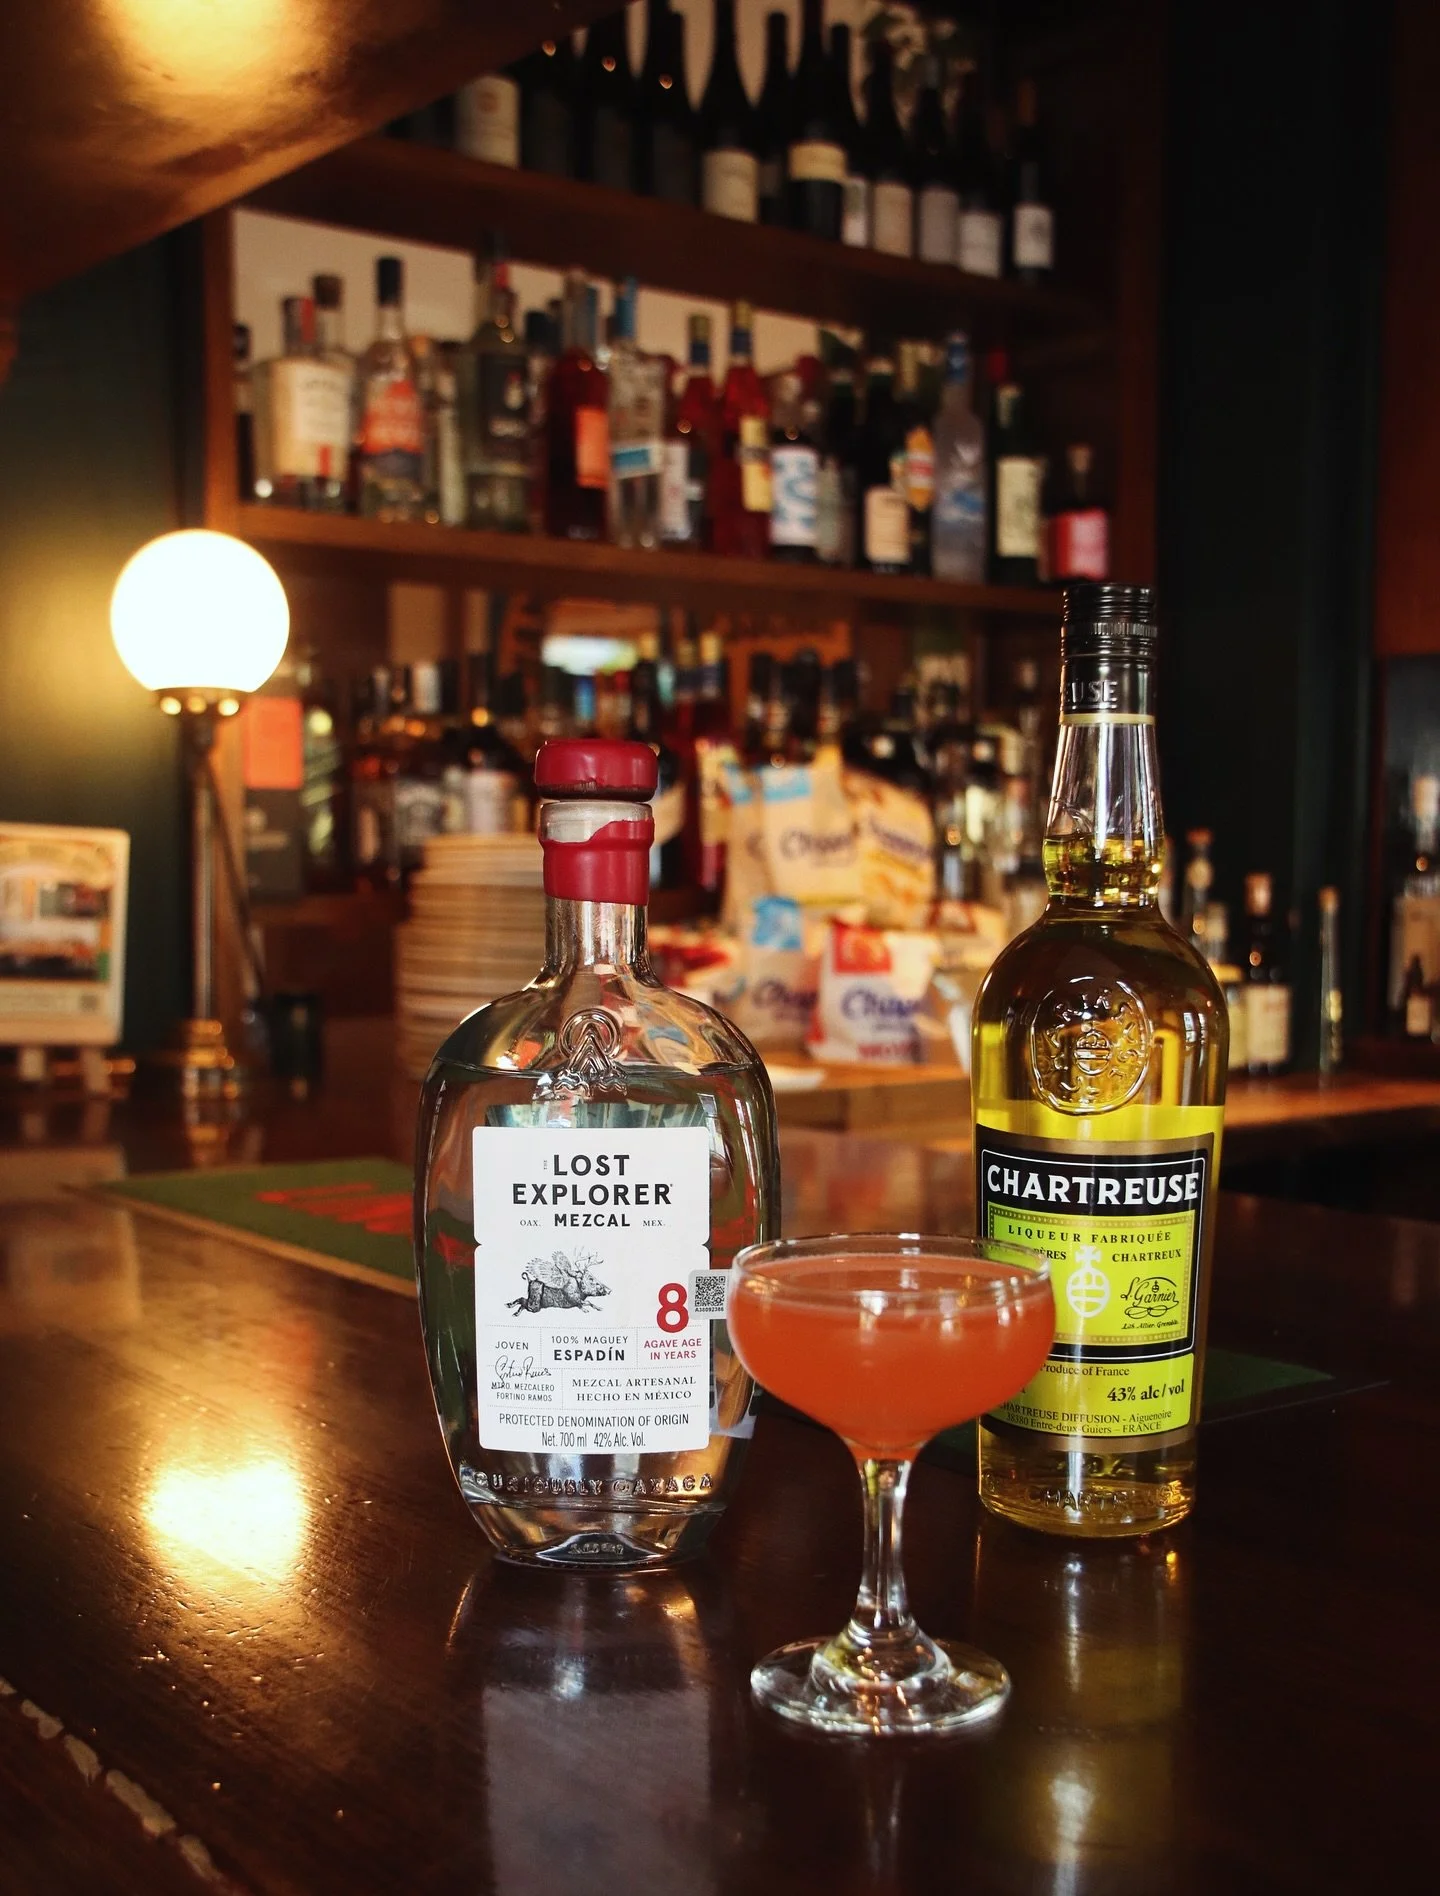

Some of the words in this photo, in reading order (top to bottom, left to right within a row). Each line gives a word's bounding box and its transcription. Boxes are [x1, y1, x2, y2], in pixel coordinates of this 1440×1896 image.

[554, 1154, 630, 1176] LOST
[987, 1164, 1199, 1205] CHARTREUSE
[512, 1183, 671, 1205] EXPLORER
[554, 1213, 631, 1228] MEZCAL
[1008, 1224, 1081, 1243] LIQUEUR
[1091, 1230, 1171, 1245] FABRIQUÉE
[1111, 1248, 1182, 1263] CHARTREUX
[656, 1283, 689, 1333] 8
[494, 1340, 529, 1350] JOVEN
[551, 1335, 579, 1345] 100%
[584, 1335, 629, 1345] MAGUEY
[643, 1338, 678, 1349] AGAVE
[681, 1337, 702, 1348] AGE
[553, 1346, 625, 1361] ESPADÍN
[650, 1352, 662, 1361] IN
[664, 1350, 697, 1360] YEARS
[1082, 1365, 1093, 1376] of
[1096, 1366, 1130, 1376] France
[514, 1382, 555, 1392] MEZCALERO
[571, 1377, 623, 1388] MEZCAL
[625, 1376, 697, 1387] ARTESANAL
[496, 1391, 525, 1401] FORTINO
[527, 1393, 553, 1402] RAMOS
[576, 1392, 620, 1402] HECHO
[624, 1392, 640, 1401] EN
[643, 1388, 692, 1401] MÉXICO
[1107, 1386, 1136, 1402] 43%
[1141, 1385, 1159, 1400] alc
[1169, 1378, 1185, 1394] vol
[499, 1413, 554, 1427] PROTECTED
[557, 1414, 634, 1427] DENOMINATION
[637, 1414, 651, 1426] OF
[654, 1412, 689, 1425] ORIGIN
[1007, 1412, 1029, 1425] 38380
[1122, 1421, 1162, 1433] FRANCE
[1061, 1412, 1120, 1423] DIFFUSION
[1129, 1409, 1172, 1424] Aiguenoire
[541, 1432, 558, 1447] Net.
[560, 1432, 575, 1447] 700
[576, 1432, 588, 1447] ml
[593, 1432, 612, 1447] 42%
[613, 1432, 630, 1447] Alc.
[631, 1432, 646, 1447] Vol.
